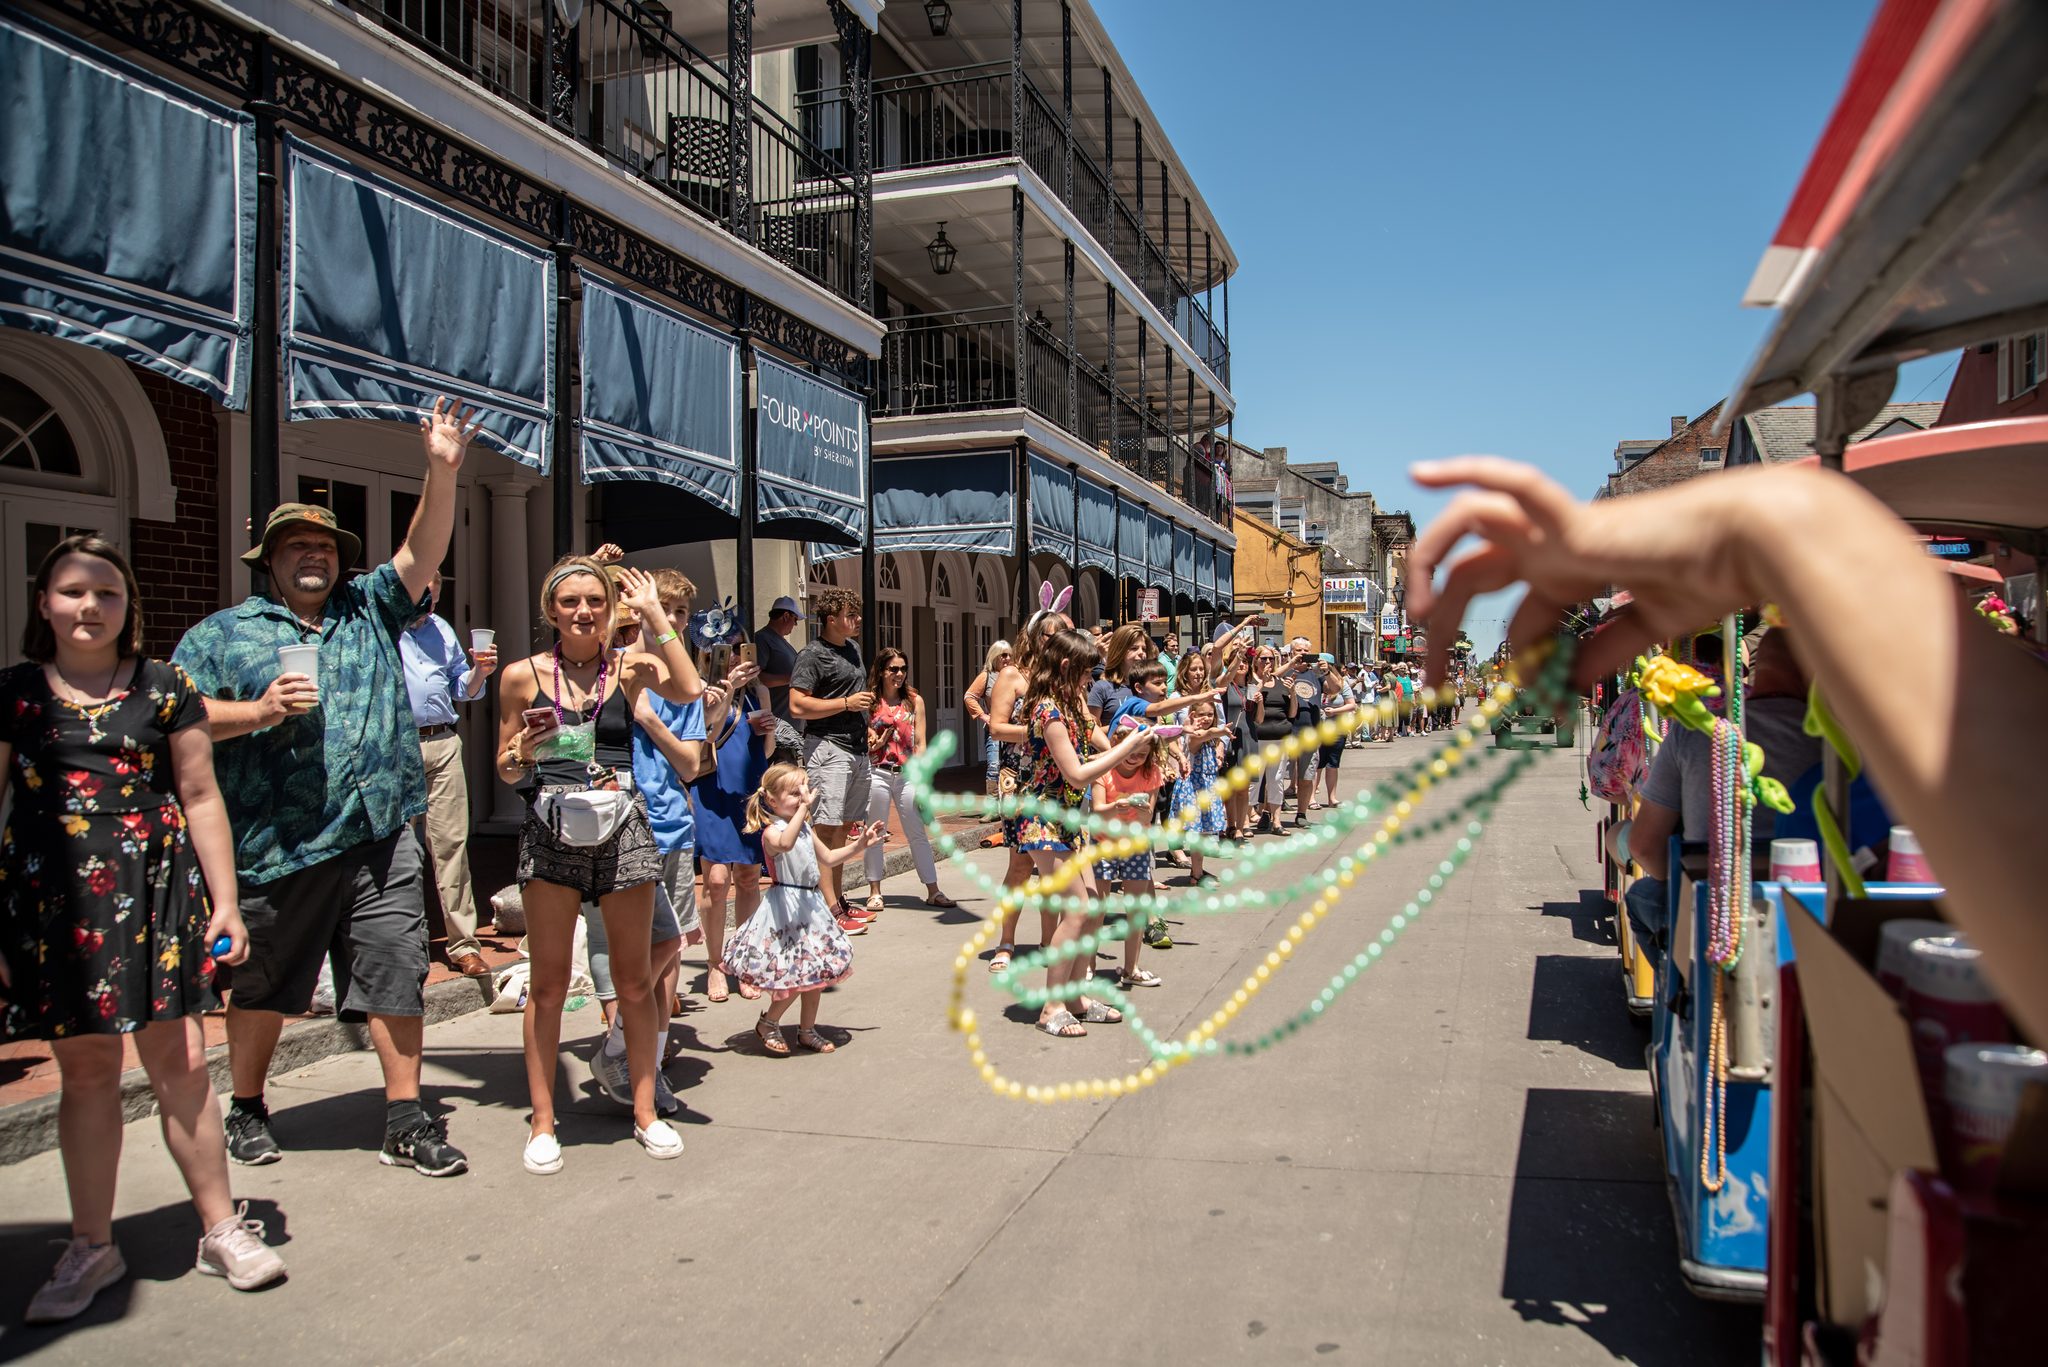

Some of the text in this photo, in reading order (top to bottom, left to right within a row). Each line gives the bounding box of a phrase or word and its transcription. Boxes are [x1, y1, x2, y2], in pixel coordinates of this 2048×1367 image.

[762, 394, 858, 452] FOUR POINTS
[813, 445, 854, 468] BY SHERATON
[1325, 580, 1365, 590] SLUSH
